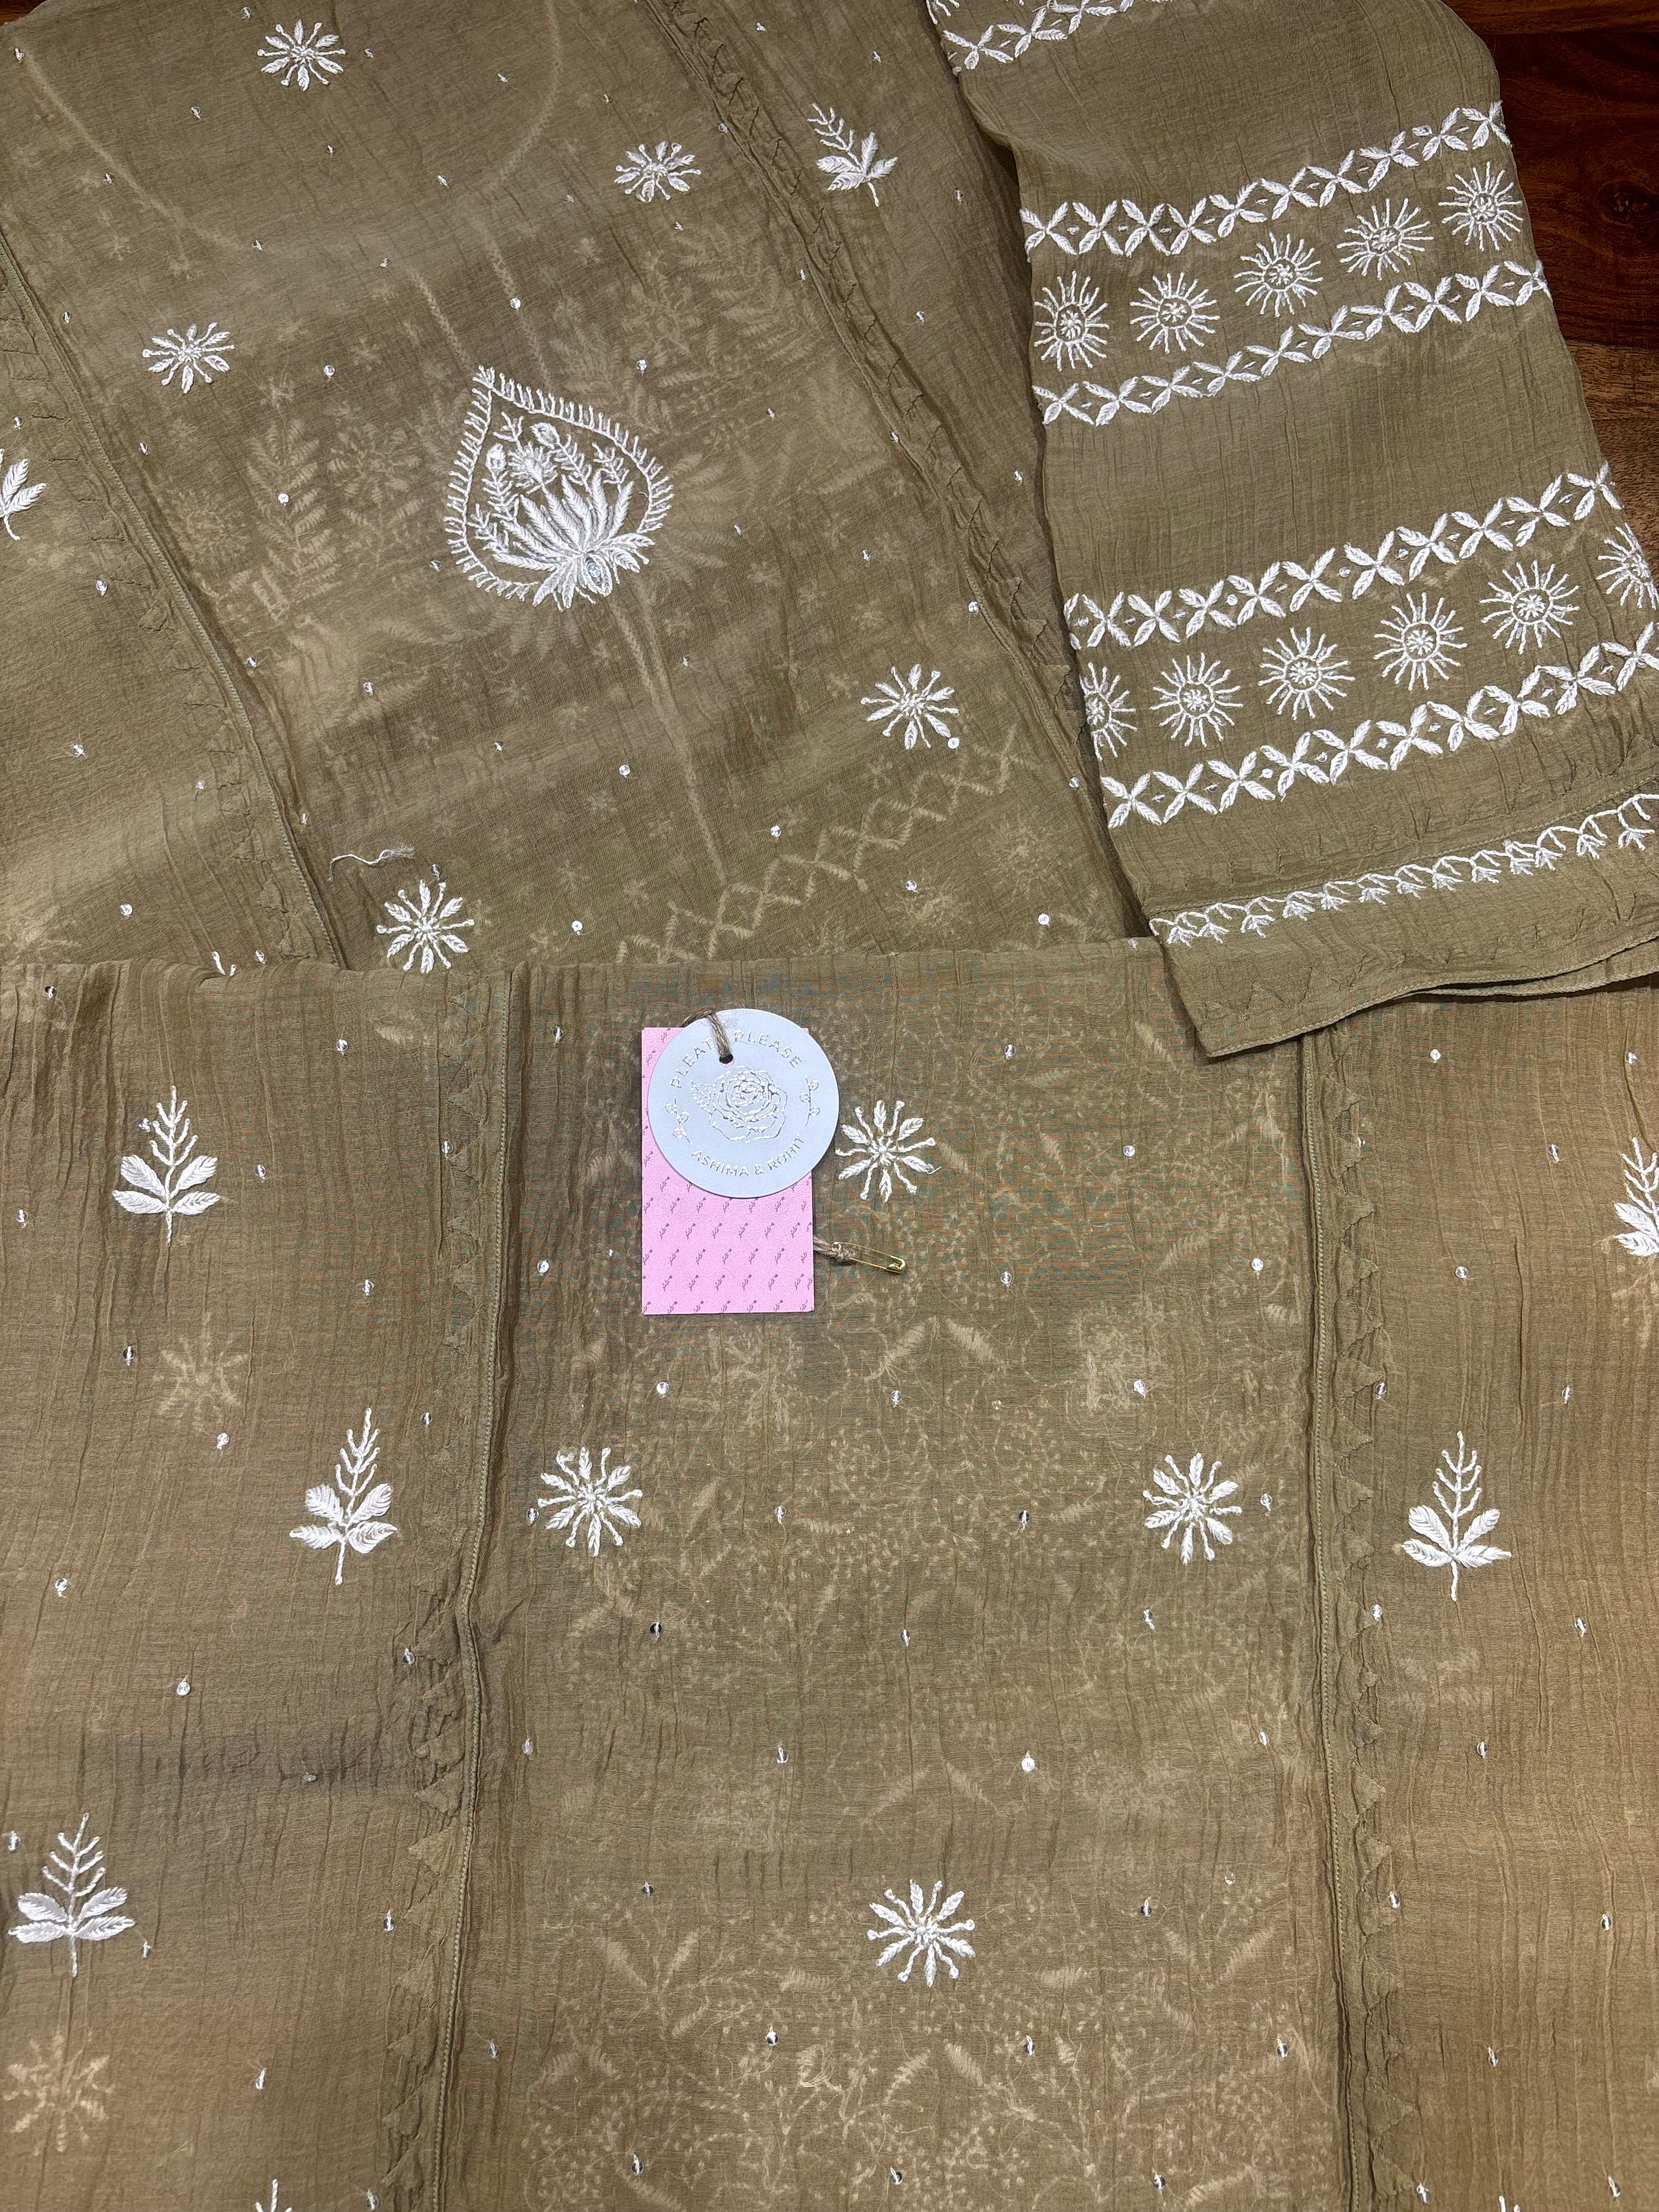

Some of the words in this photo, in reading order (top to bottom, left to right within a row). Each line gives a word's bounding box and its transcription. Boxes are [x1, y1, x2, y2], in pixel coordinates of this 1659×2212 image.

[733, 1029, 803, 1069] PLEASE
[691, 1150, 749, 1176] ASHIMA
[754, 1163, 764, 1175] &
[767, 1133, 805, 1171] ROHIT
